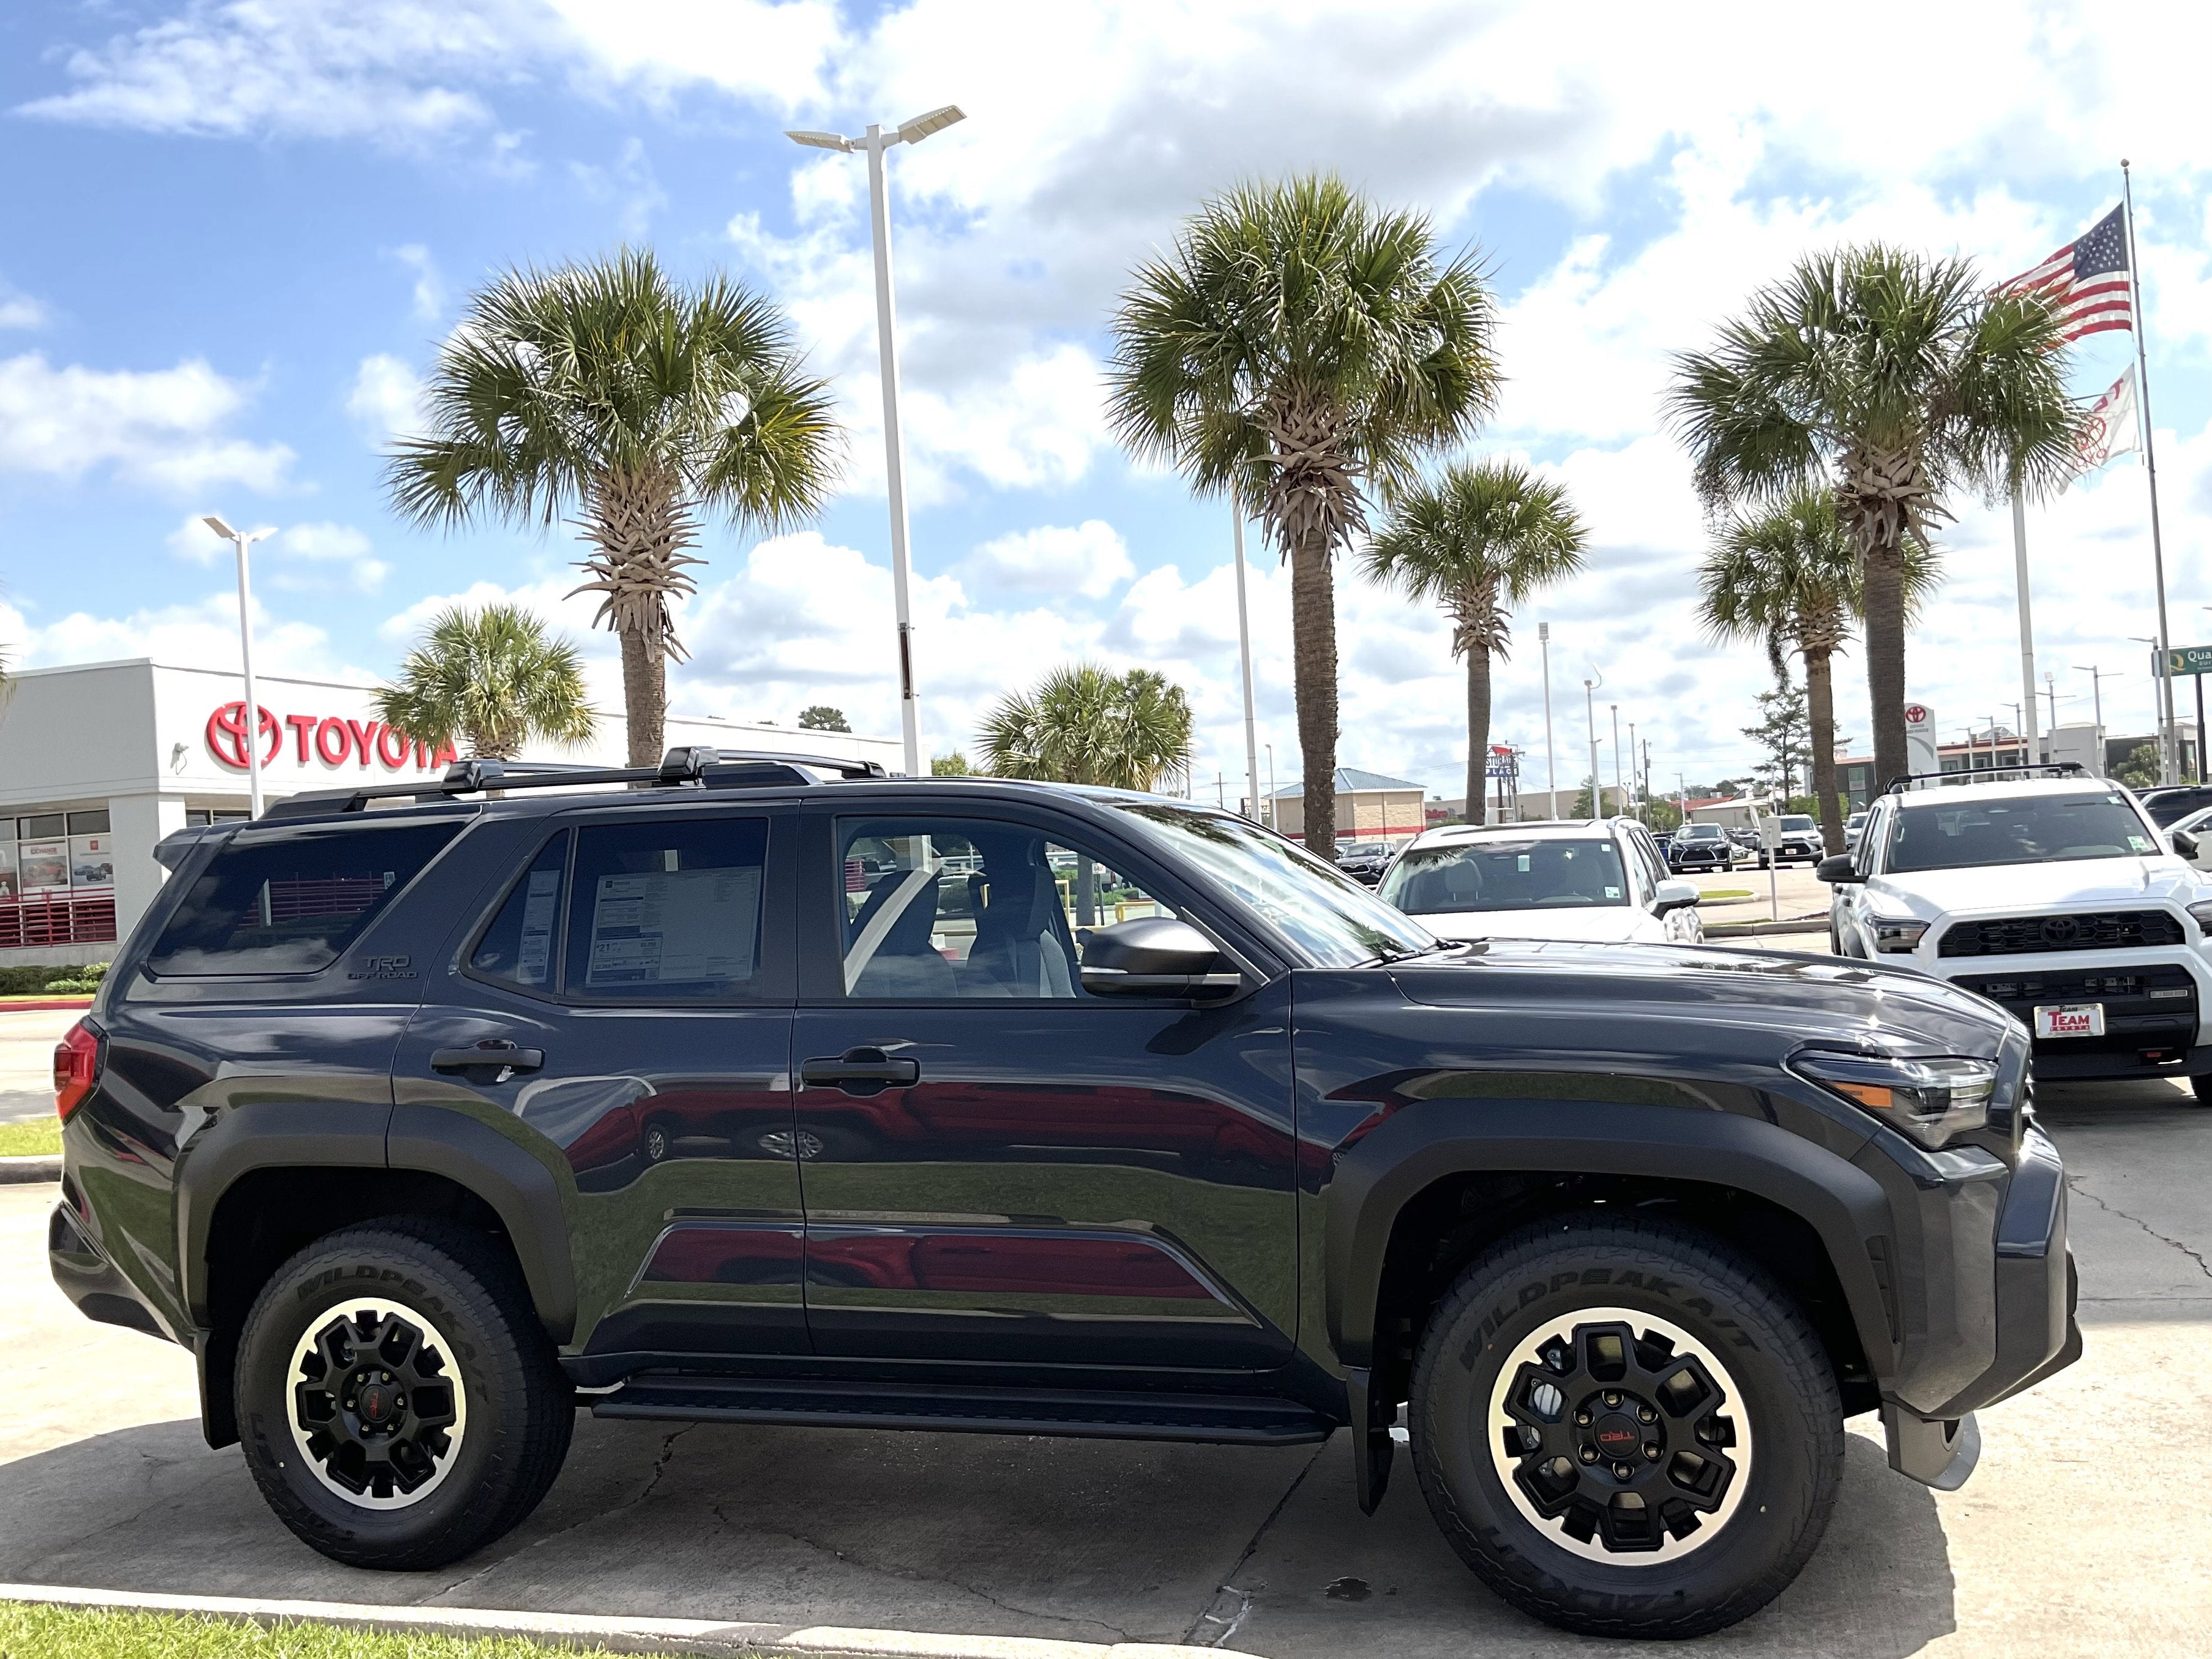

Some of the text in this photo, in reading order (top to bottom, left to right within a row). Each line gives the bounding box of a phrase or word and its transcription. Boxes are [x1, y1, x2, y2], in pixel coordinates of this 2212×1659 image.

[363, 955, 411, 972] TRD
[2047, 1011, 2090, 1026] TEAM
[297, 1265, 465, 1333] WILDPEAK
[1459, 1267, 1684, 1373] WILDPEAK
[1599, 1430, 1635, 1442] TRD
